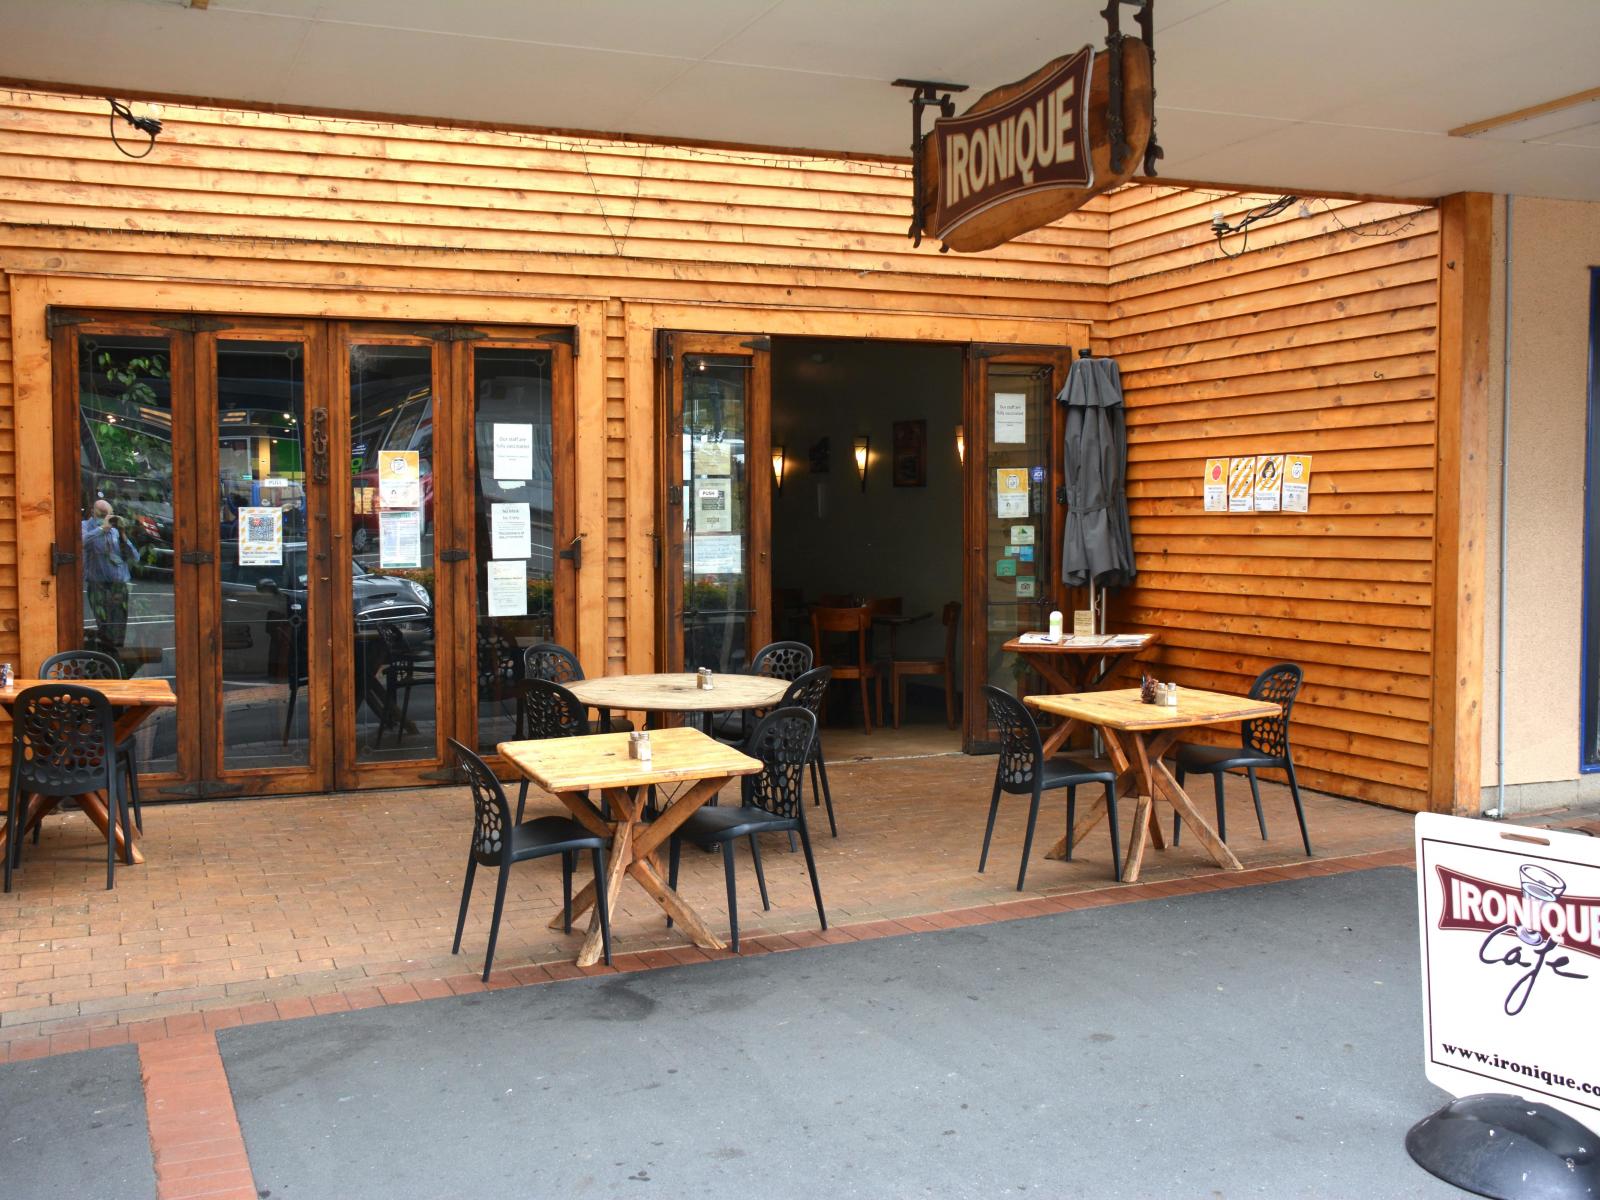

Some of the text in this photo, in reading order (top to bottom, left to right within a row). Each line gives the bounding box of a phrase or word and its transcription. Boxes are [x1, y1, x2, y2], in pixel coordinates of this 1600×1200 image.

[946, 76, 1075, 208] IRONIQUE
[1450, 877, 1600, 948] IRONIQUE
[1479, 923, 1589, 1016] Cafe
